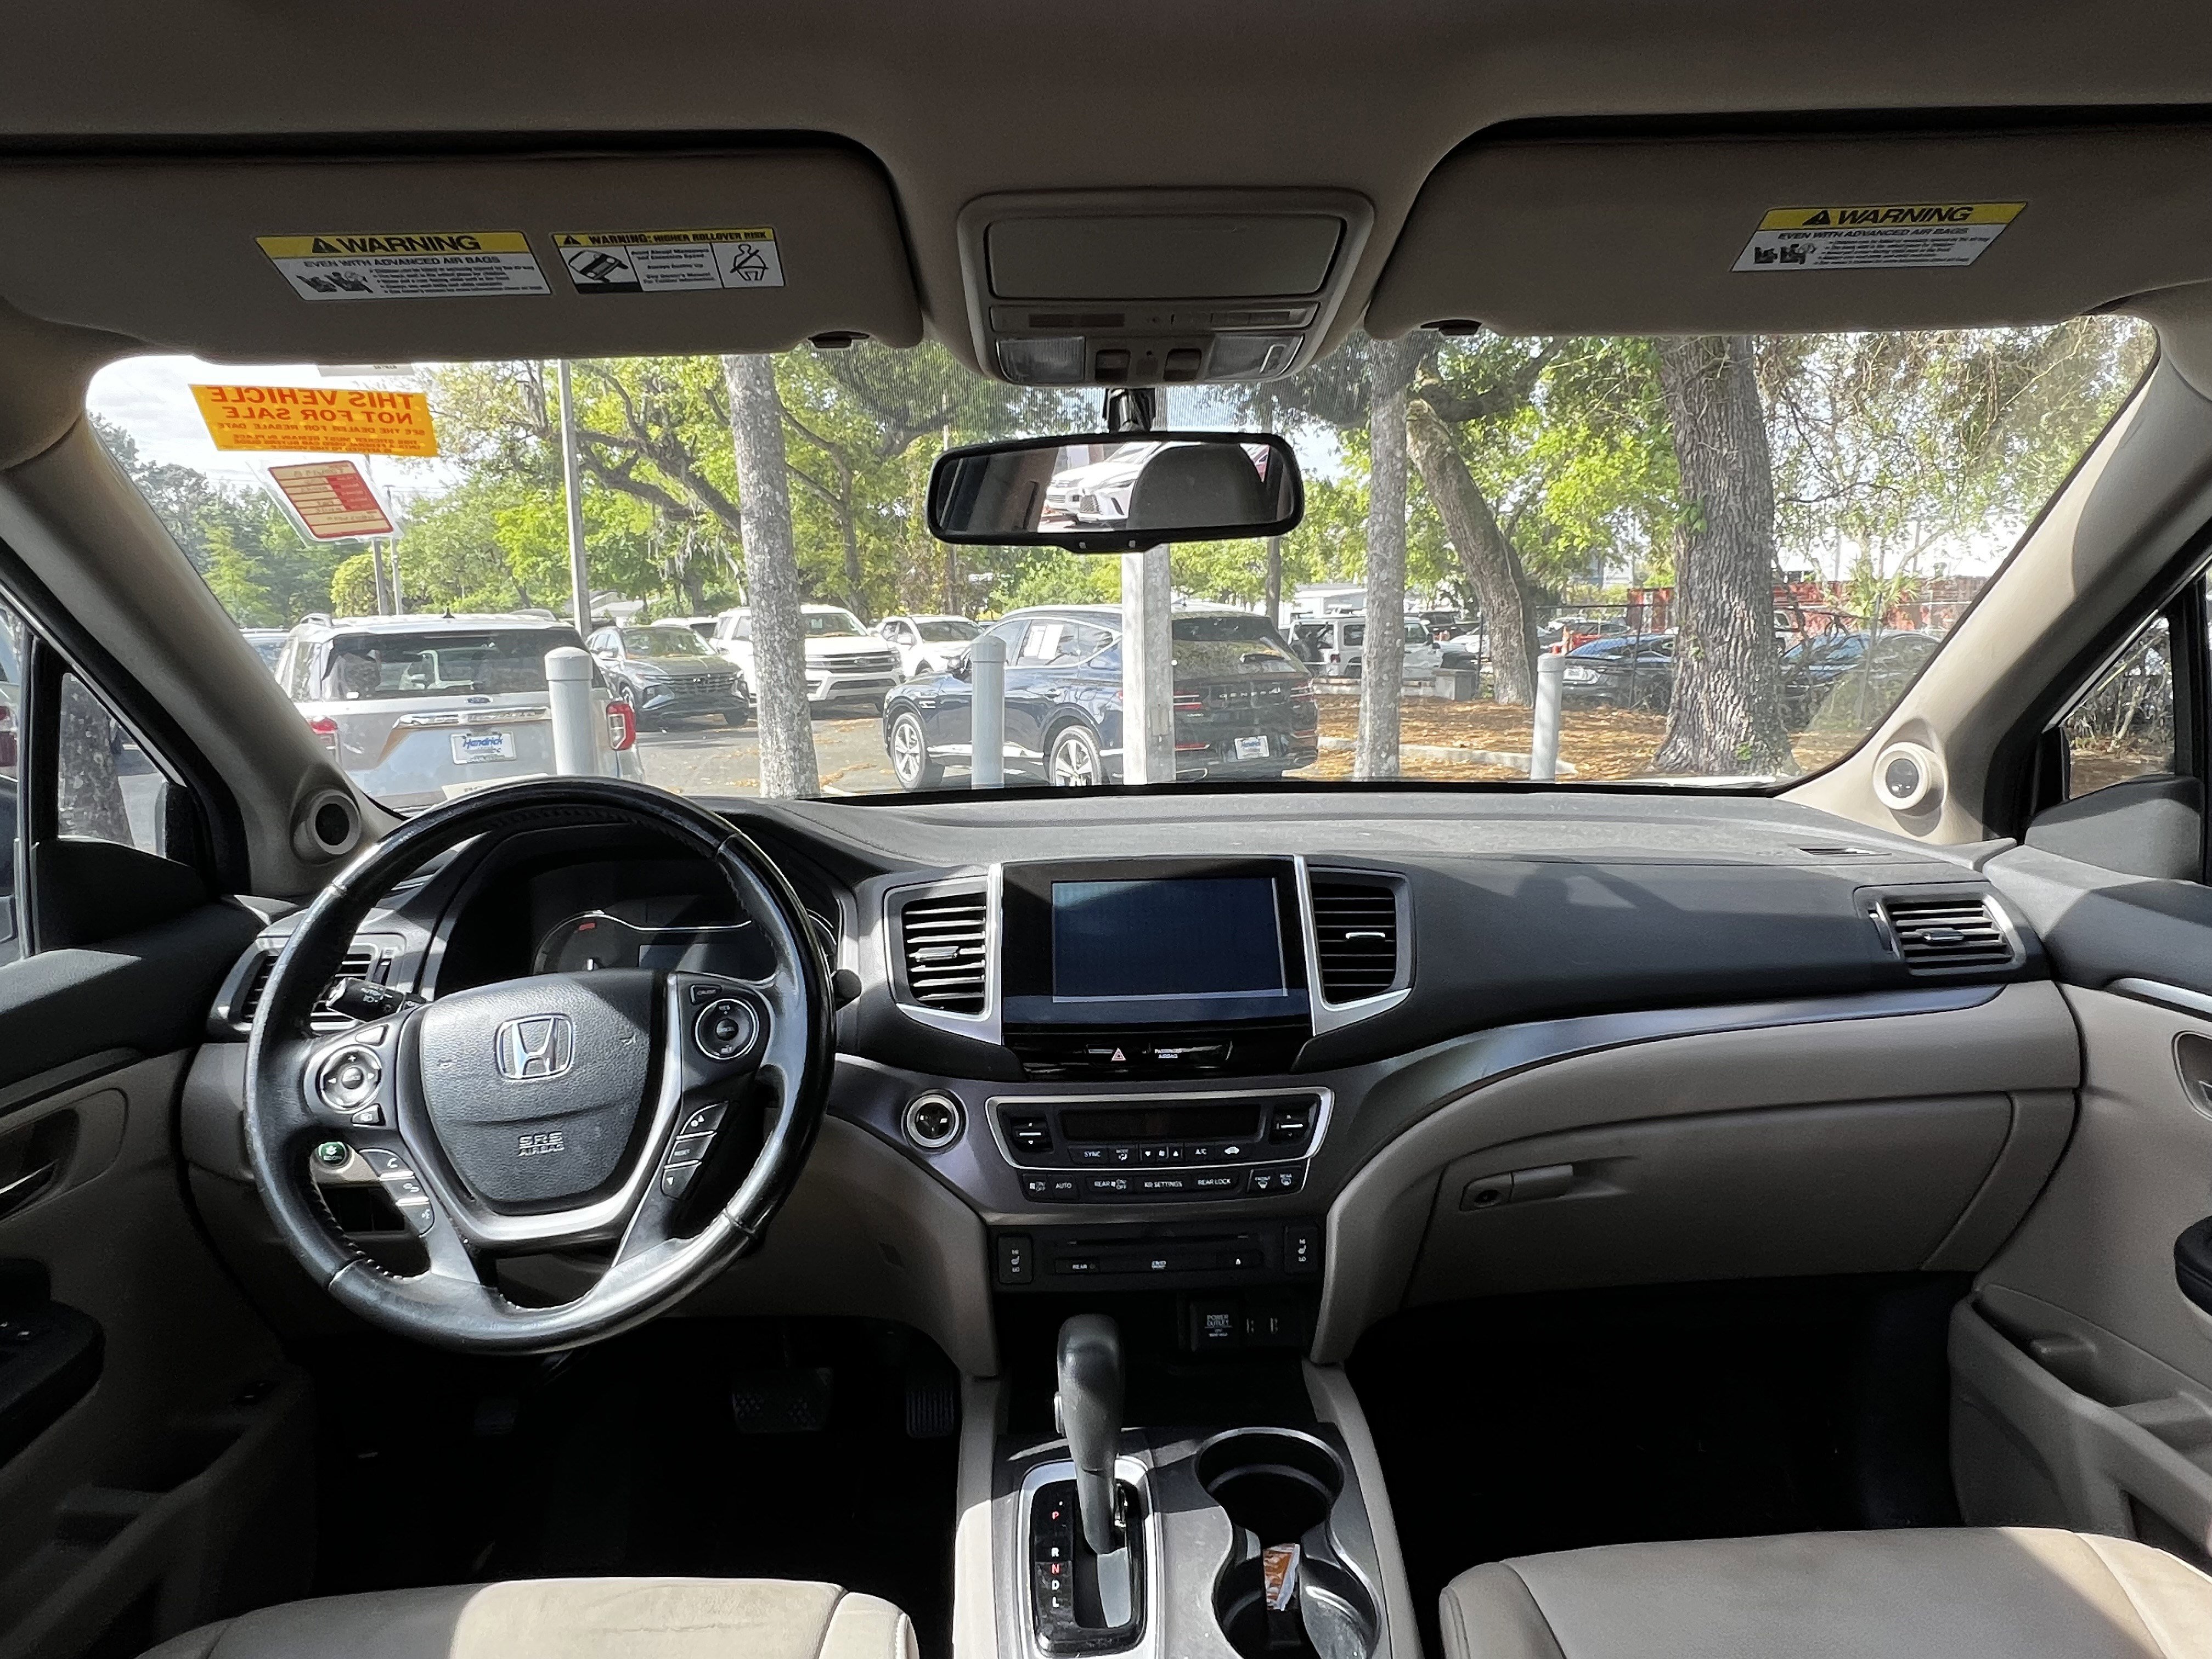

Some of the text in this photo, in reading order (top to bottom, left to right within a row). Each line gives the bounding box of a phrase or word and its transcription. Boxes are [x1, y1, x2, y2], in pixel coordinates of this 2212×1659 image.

[1838, 207, 1974, 225] WARNING
[1844, 229, 1911, 237] ADVANCED
[336, 235, 482, 253] WARNING
[519, 1131, 563, 1147] SRS
[1051, 1511, 1059, 1520] P
[1051, 1547, 1059, 1558] R
[1051, 1564, 1061, 1575] N
[1051, 1579, 1060, 1591] D
[1052, 1596, 1060, 1608] L
